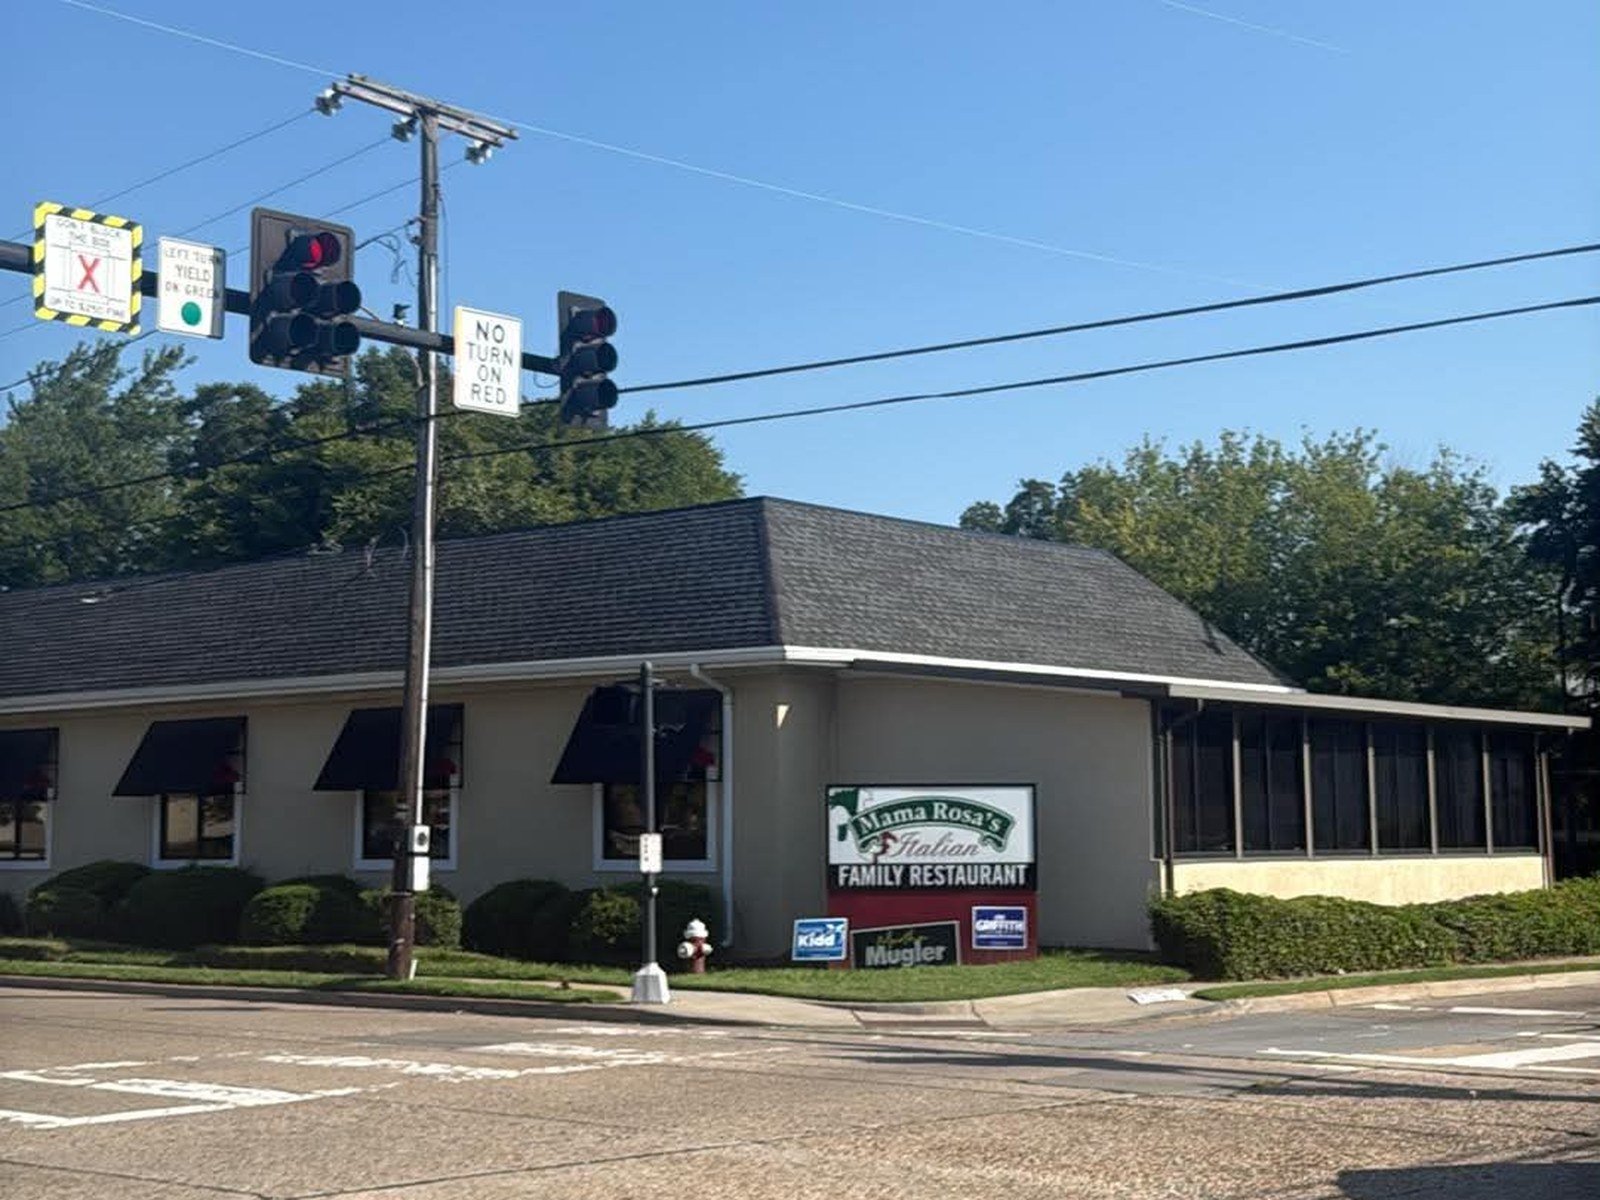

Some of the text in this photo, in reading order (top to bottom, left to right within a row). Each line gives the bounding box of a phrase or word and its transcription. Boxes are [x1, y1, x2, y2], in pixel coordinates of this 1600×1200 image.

[165, 247, 188, 260] LEFT
[175, 264, 211, 283] YIELD
[165, 281, 179, 292] ON
[476, 320, 505, 344] NO
[467, 341, 513, 367] TURN
[477, 364, 502, 383] ON
[471, 383, 506, 404] RED
[859, 802, 1002, 835] Mama Rosa's
[886, 831, 980, 858] Italian
[838, 865, 1028, 887] FAMILY RESTAURANT
[798, 933, 836, 947] Kidd
[865, 941, 947, 967] Mugler
